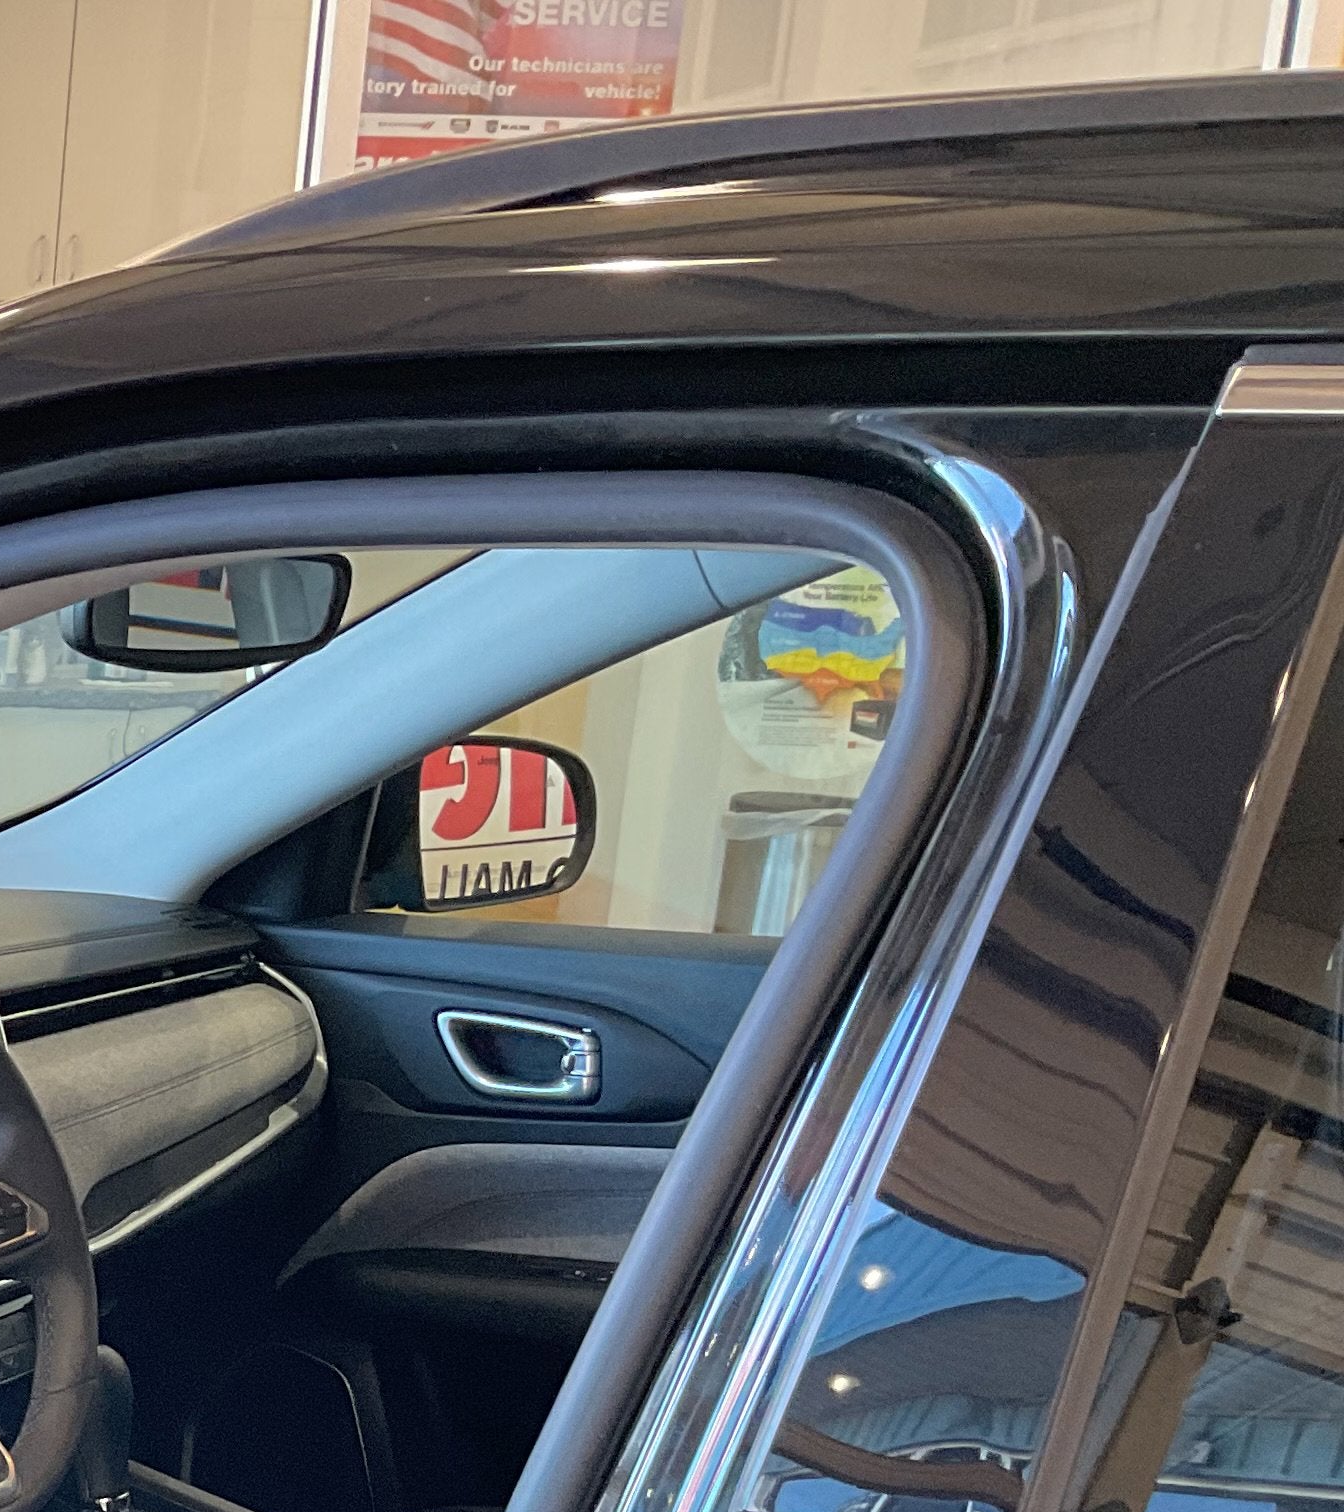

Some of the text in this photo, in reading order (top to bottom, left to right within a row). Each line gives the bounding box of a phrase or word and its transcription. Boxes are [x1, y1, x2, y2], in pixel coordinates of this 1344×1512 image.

[514, 0, 670, 28] SERVICE
[469, 55, 664, 76] Our technicians are
[412, 78, 481, 97] trained
[488, 80, 516, 98] for
